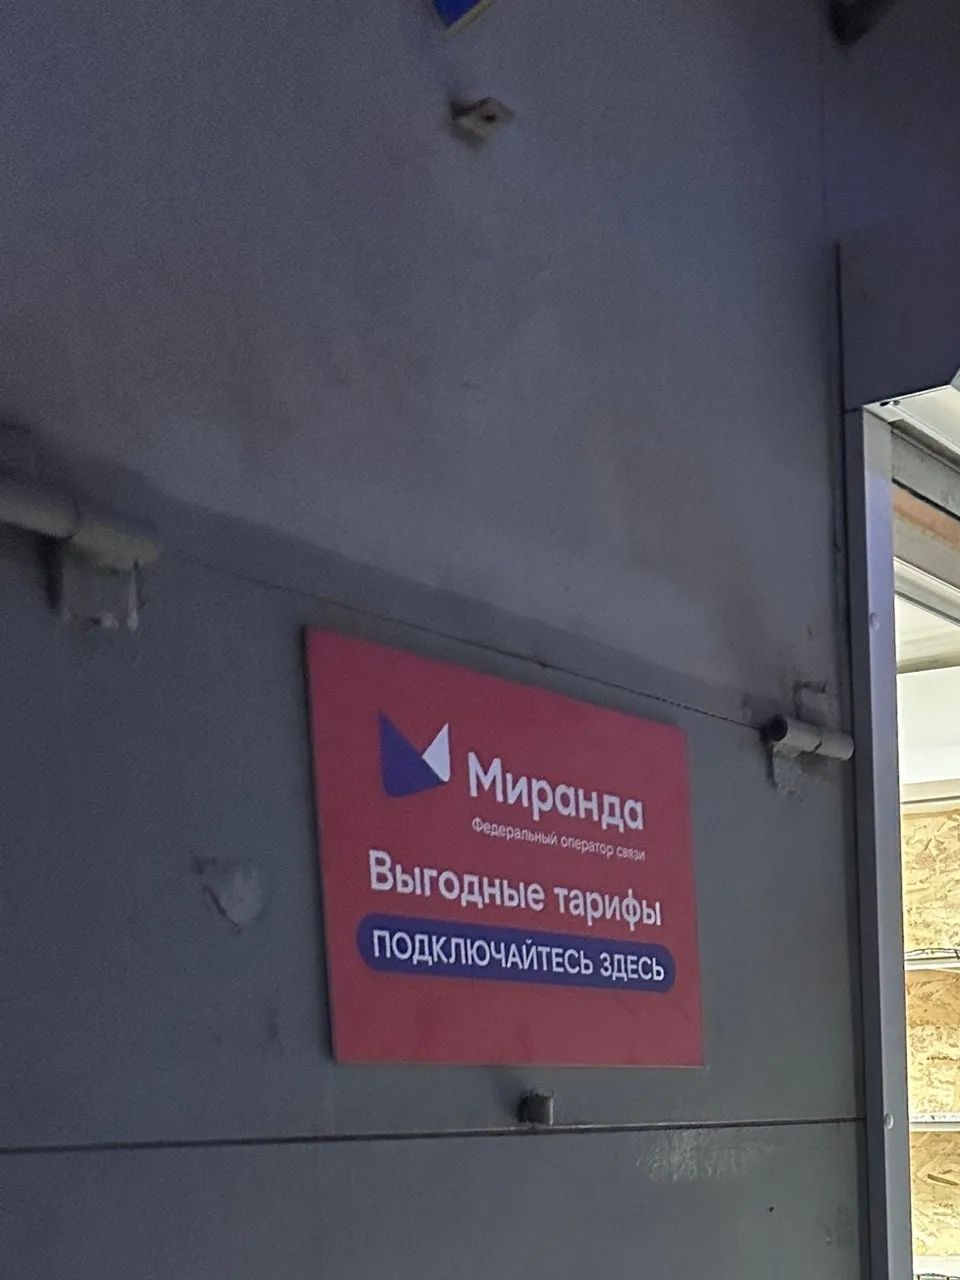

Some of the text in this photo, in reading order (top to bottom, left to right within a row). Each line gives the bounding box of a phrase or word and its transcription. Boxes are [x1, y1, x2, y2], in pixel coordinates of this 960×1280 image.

[467, 751, 645, 833] Миранда
[471, 816, 646, 862] Федеральный оператор связи
[368, 849, 662, 931] Выгодные тарифы
[372, 928, 665, 982] ПОДКЛЮЧАЙТЕСЬ ЗДЕСЬ
